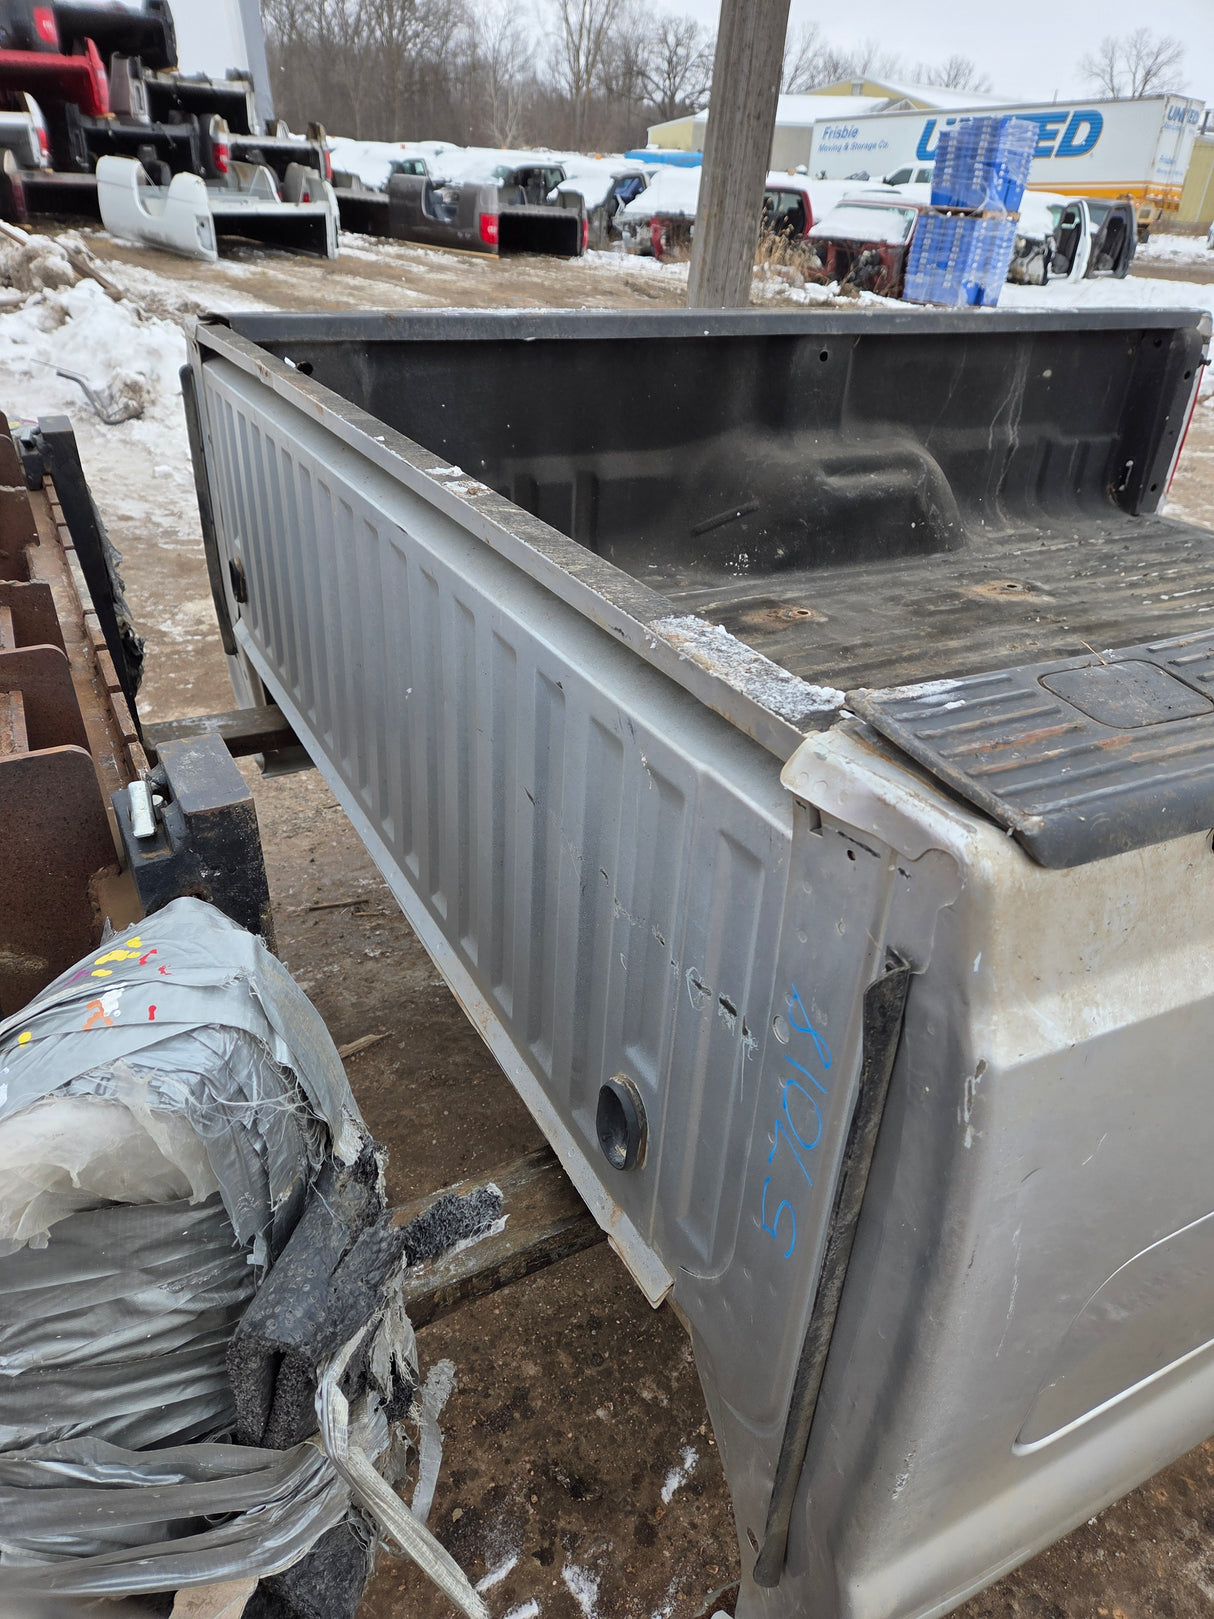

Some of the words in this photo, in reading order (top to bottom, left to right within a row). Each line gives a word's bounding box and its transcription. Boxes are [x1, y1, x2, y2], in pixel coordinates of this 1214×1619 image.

[822, 124, 859, 140] Frisbie
[818, 143, 842, 153] Moving
[850, 141, 877, 151] Storage
